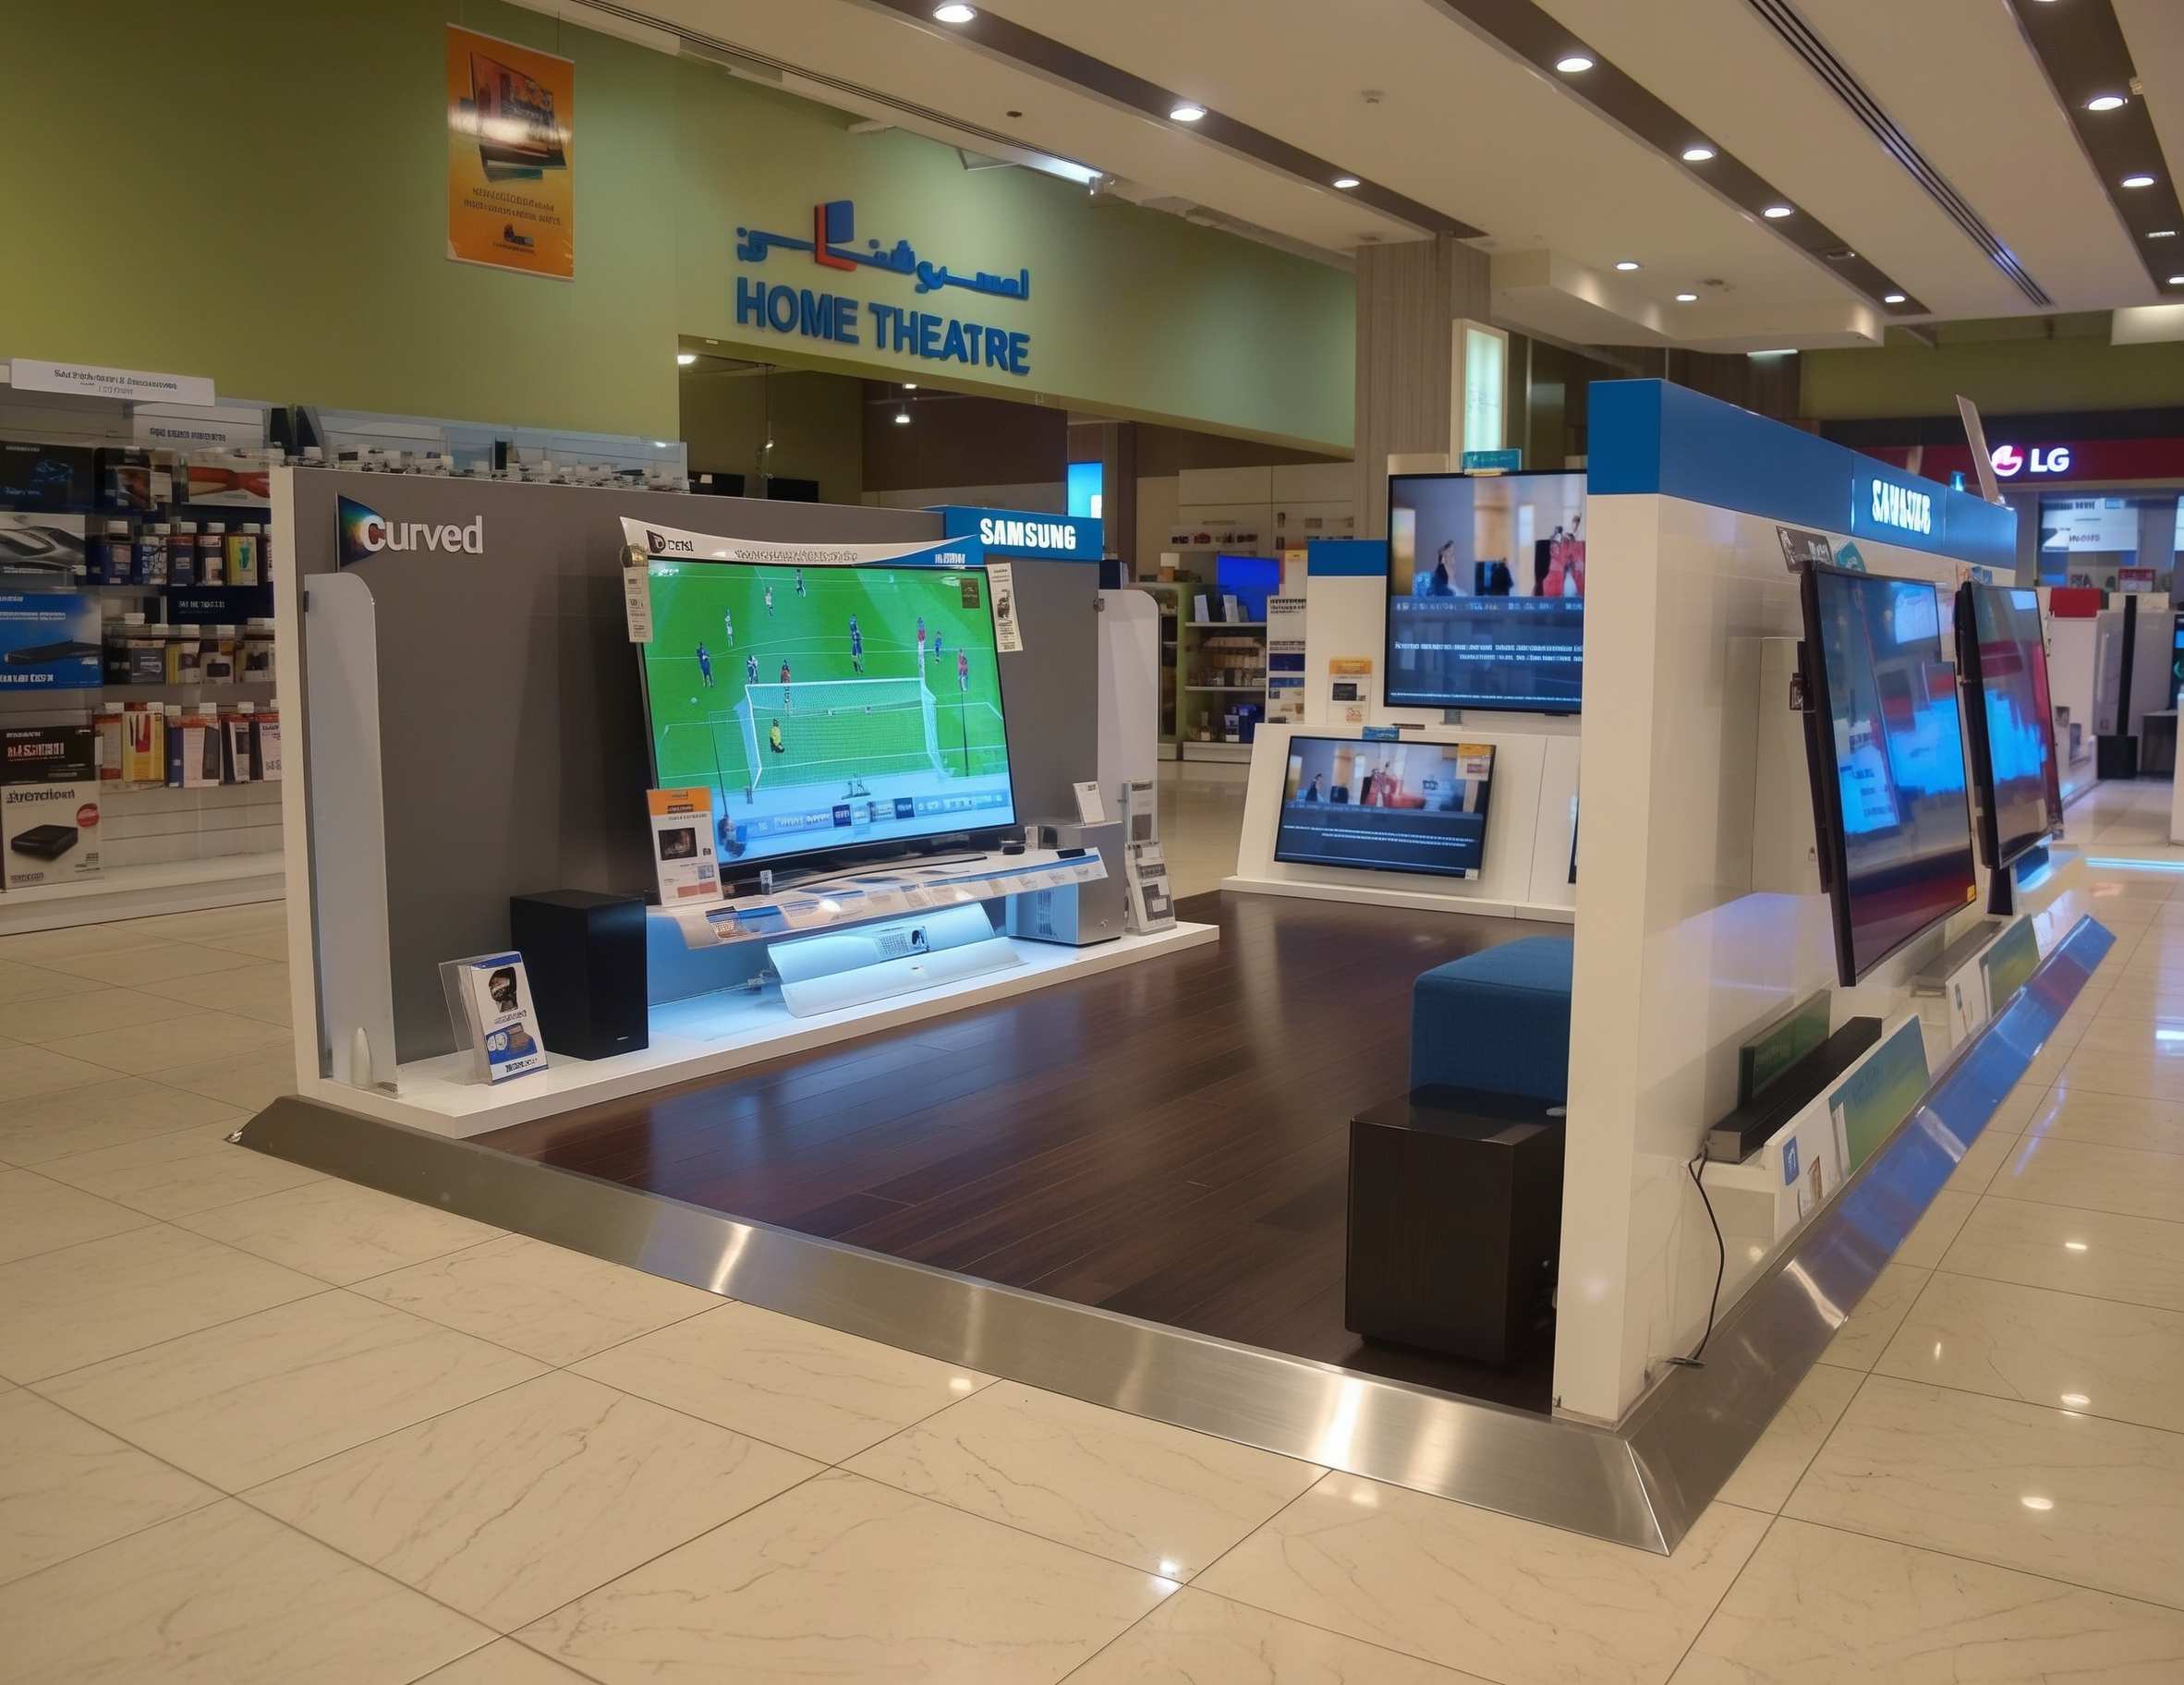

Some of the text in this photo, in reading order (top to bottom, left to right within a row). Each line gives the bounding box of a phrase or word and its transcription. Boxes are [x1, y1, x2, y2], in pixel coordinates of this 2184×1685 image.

[736, 276, 1032, 377] HOME THEATRE
[2030, 447, 2070, 473] LG
[360, 514, 484, 554] Curved
[979, 517, 1076, 550] SAMSUNG
